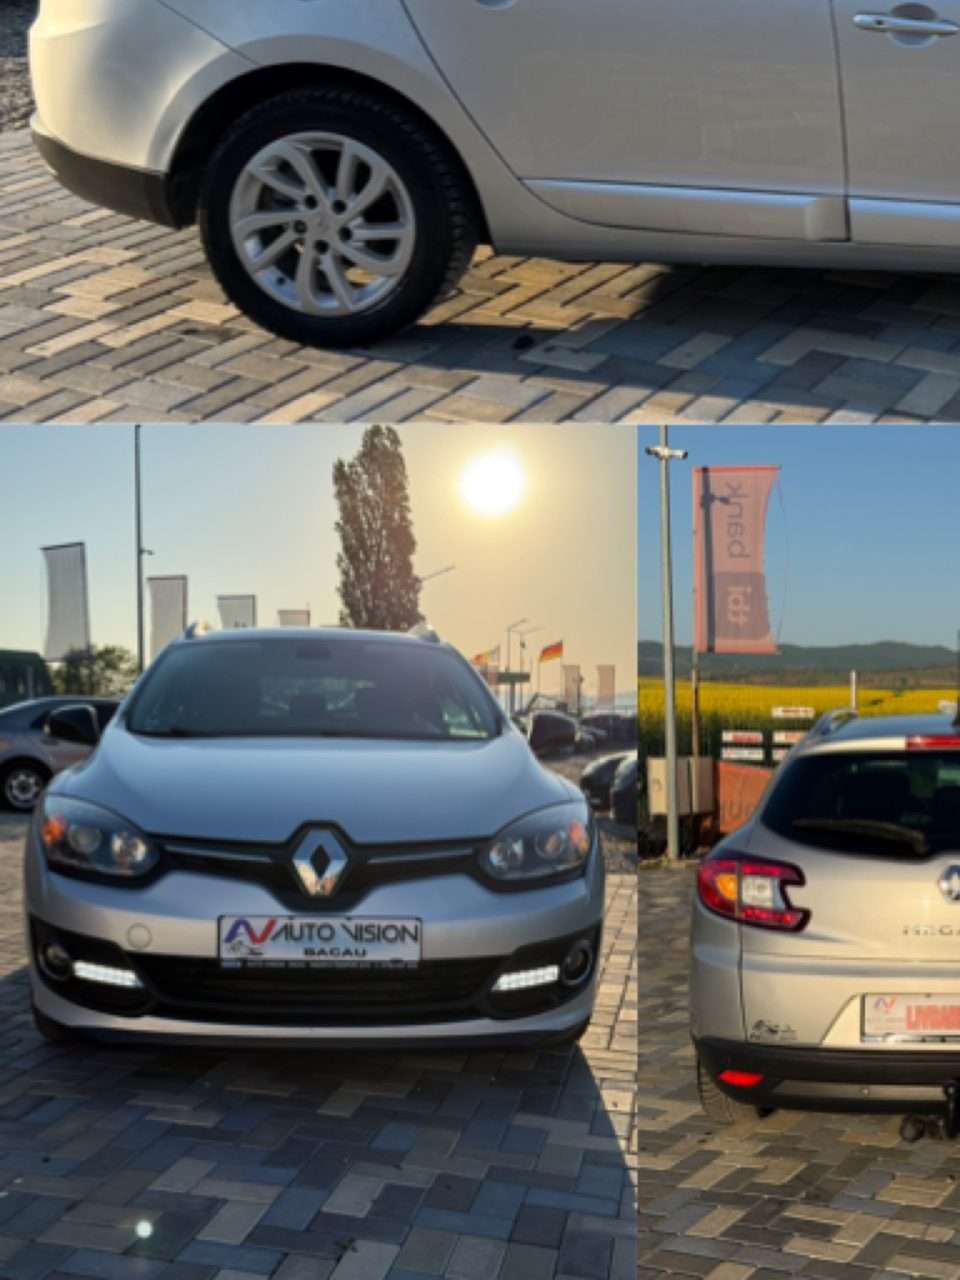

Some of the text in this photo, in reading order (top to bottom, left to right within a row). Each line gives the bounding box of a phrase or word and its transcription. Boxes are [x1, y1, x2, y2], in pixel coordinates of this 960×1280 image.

[271, 922, 336, 943] AUTO
[341, 922, 419, 944] VISION
[303, 947, 367, 958] BACAU
